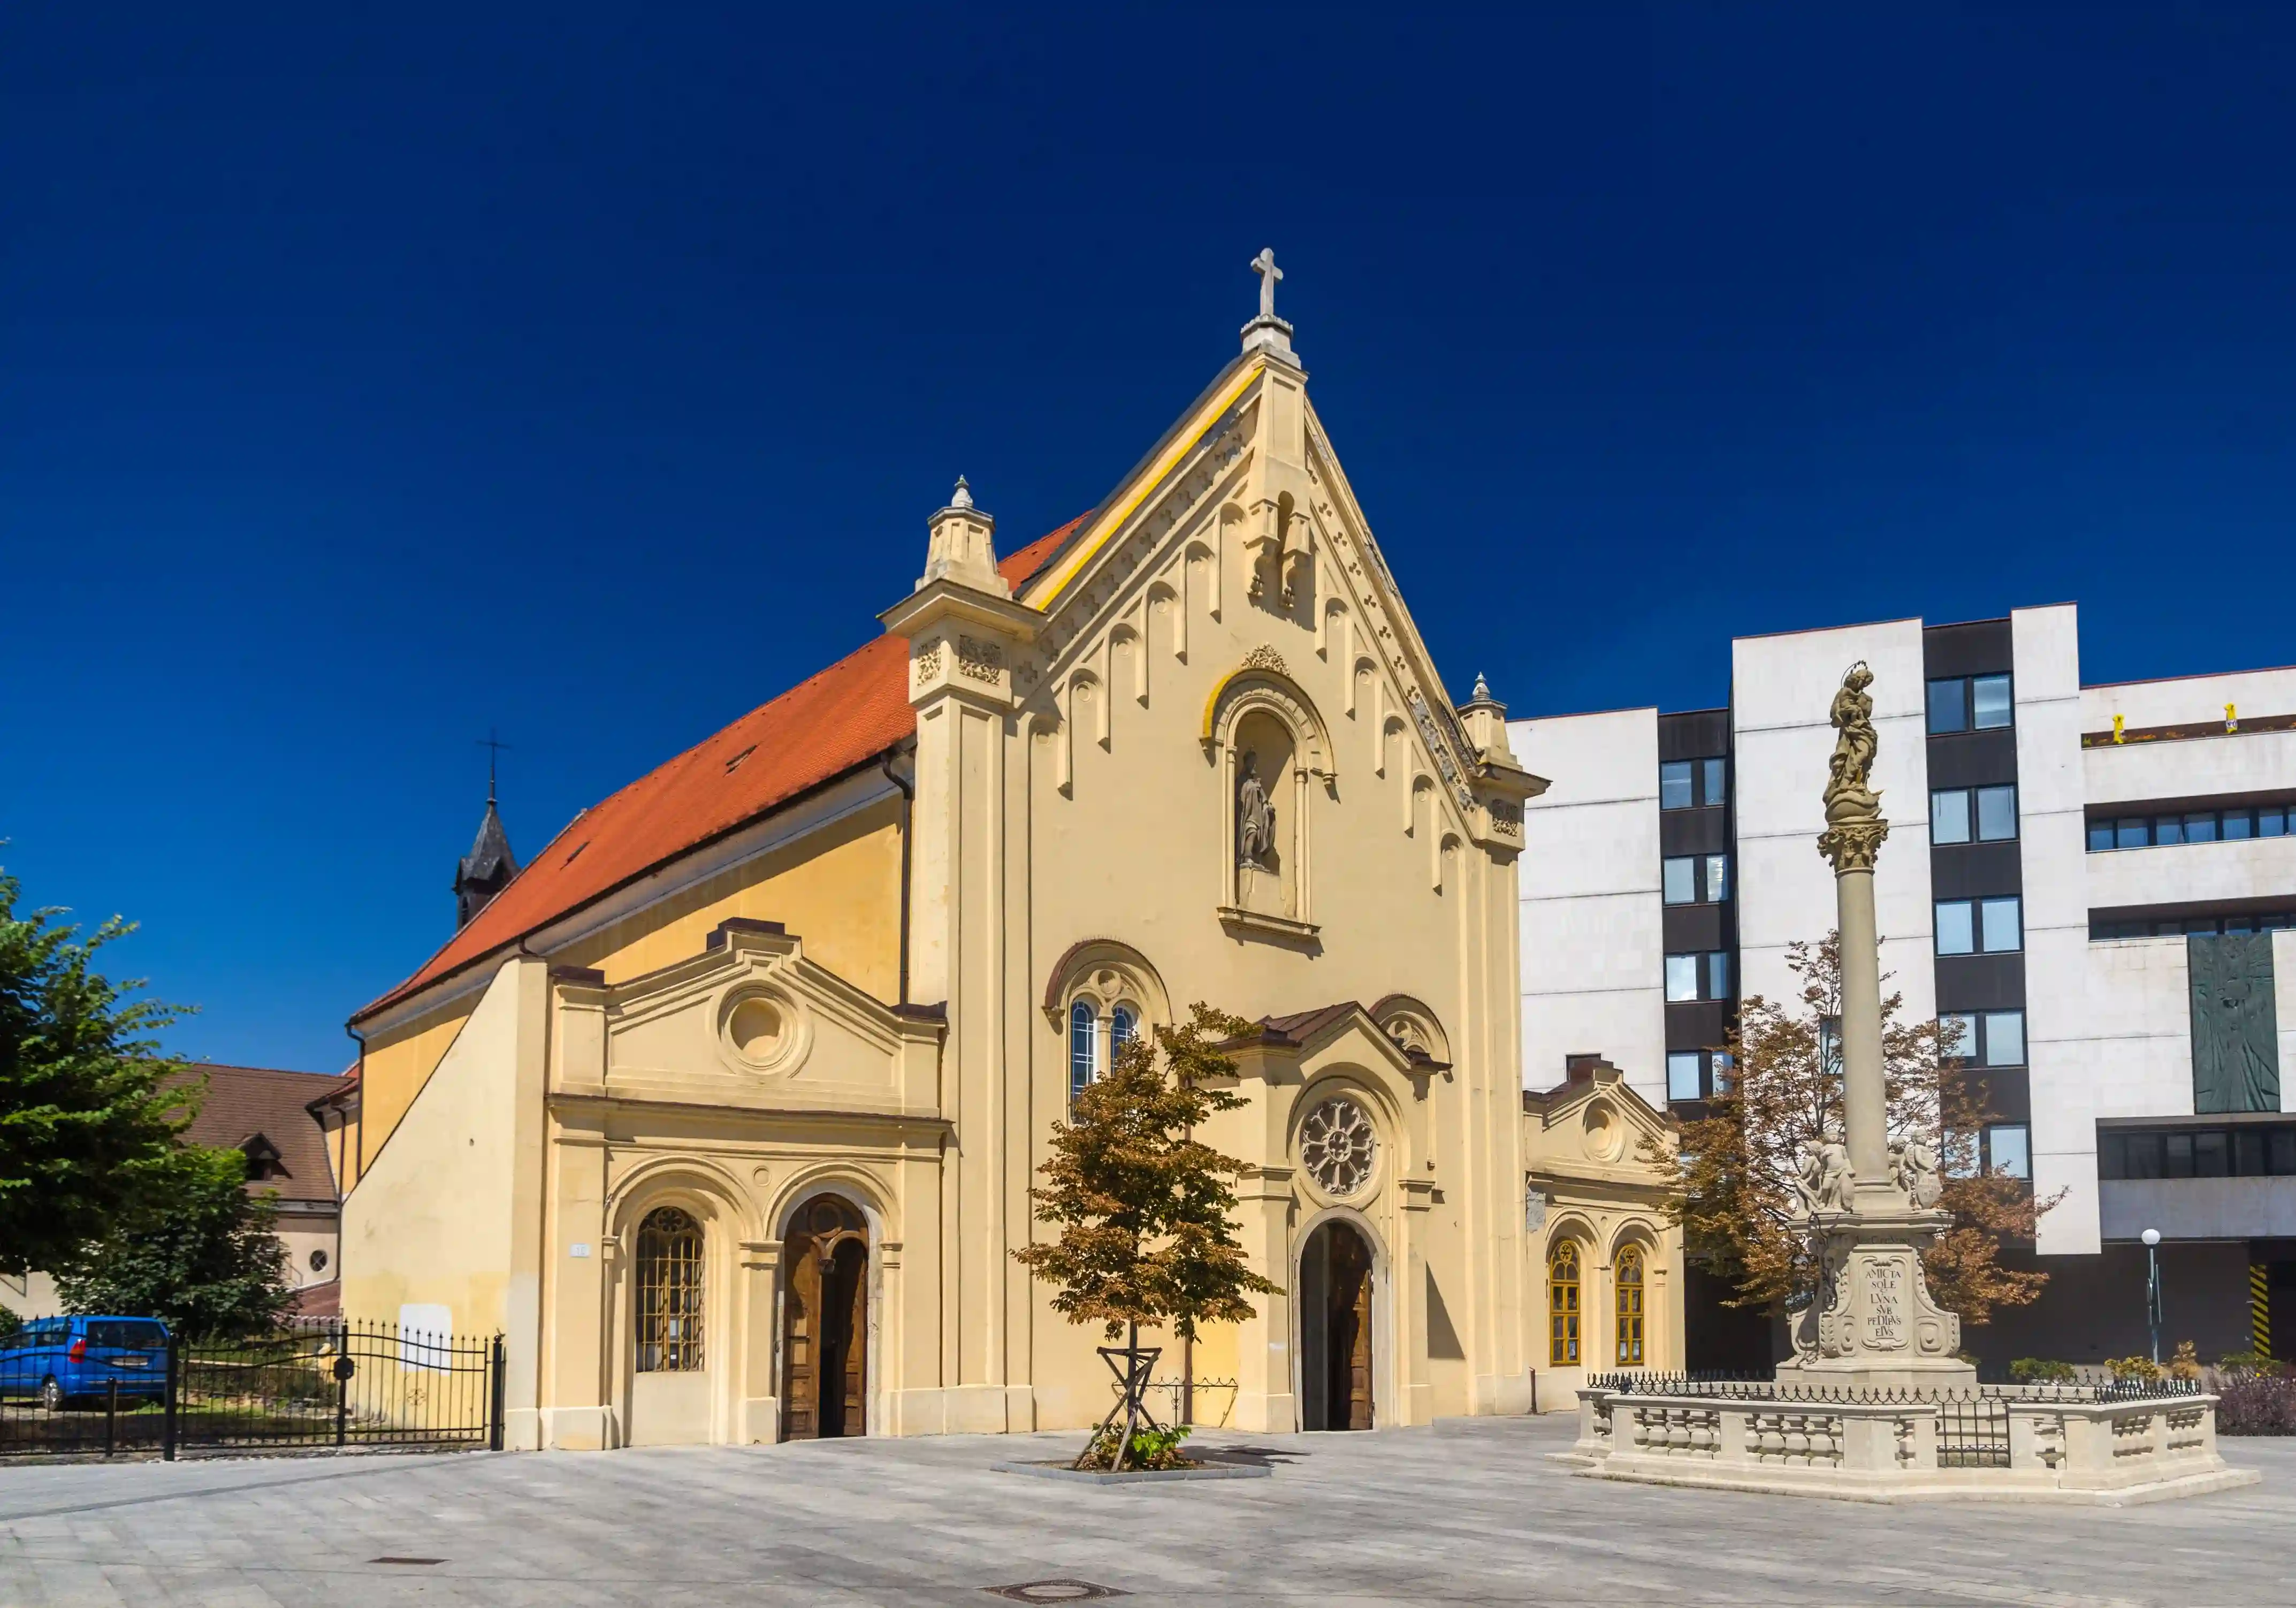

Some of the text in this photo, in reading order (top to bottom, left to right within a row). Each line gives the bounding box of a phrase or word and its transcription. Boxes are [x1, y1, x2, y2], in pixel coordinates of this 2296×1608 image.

[1865, 1269, 1901, 1278] AMICTA
[1871, 1278, 1896, 1289] SOLE
[1871, 1293, 1898, 1304] LVNA
[1877, 1305, 1892, 1314] SVB
[1867, 1315, 1901, 1325] PEDIBVS
[1875, 1325, 1894, 1336] EIVS
